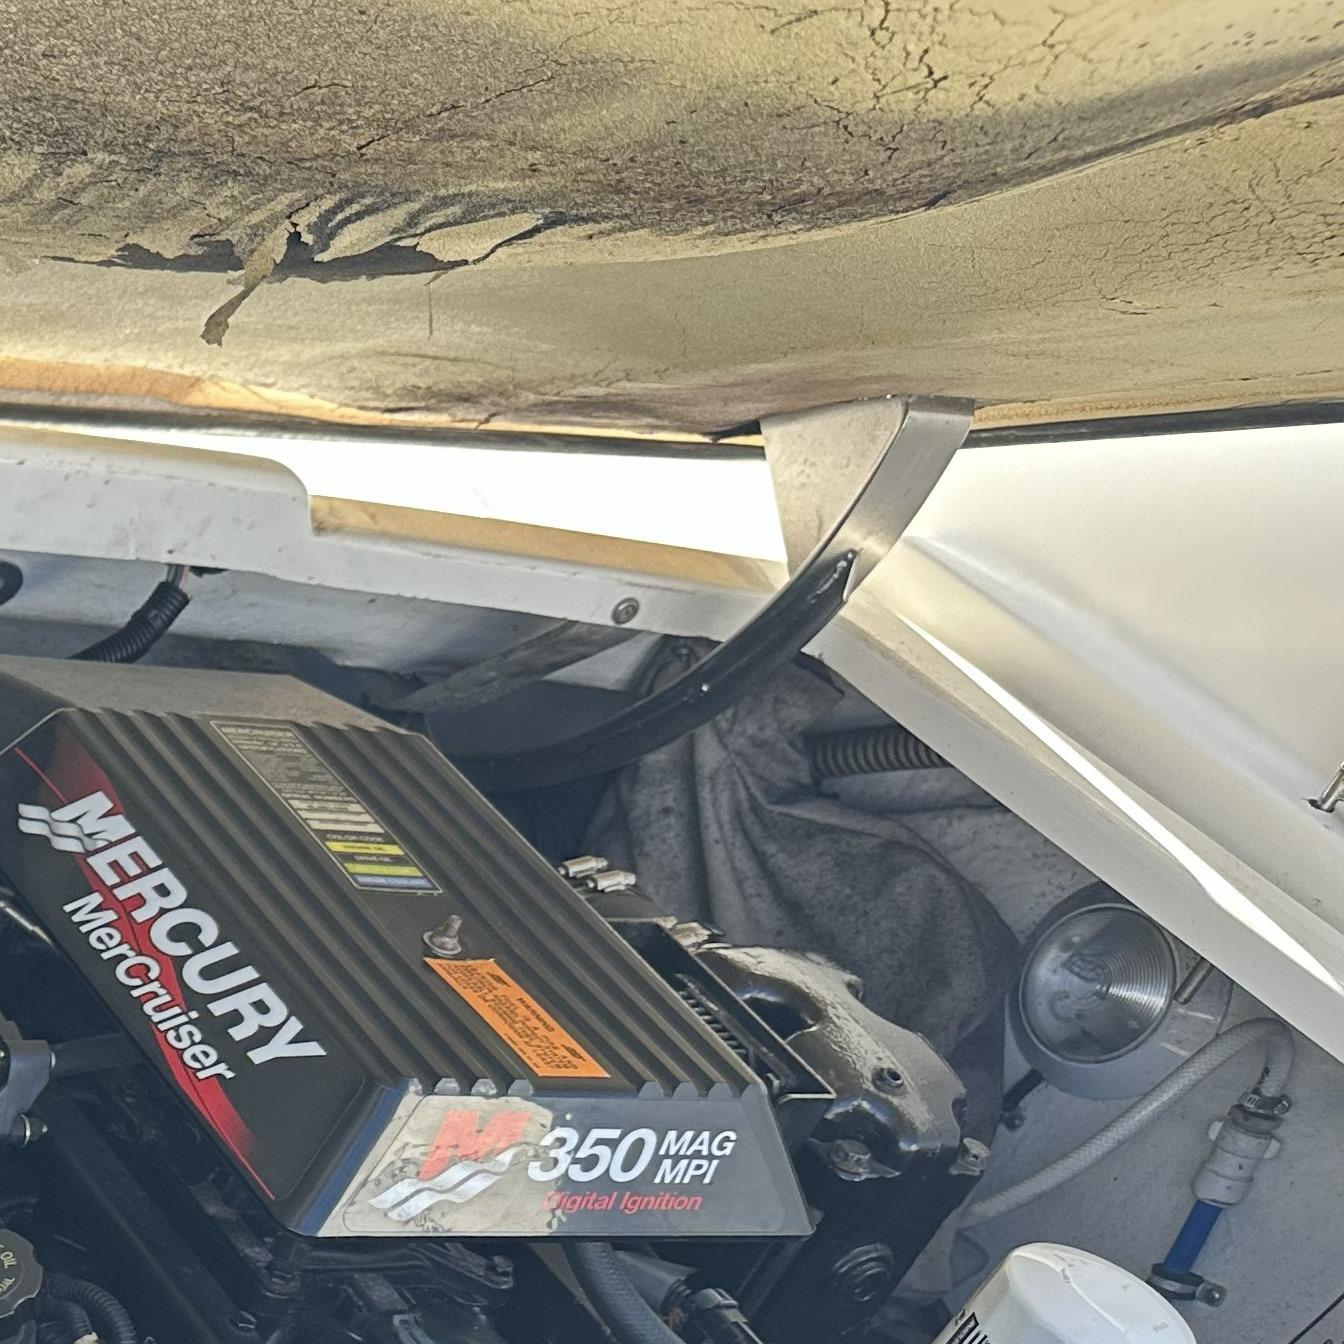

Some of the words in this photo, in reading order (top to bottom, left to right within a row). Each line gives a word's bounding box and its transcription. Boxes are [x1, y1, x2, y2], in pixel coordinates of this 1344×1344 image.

[53, 791, 326, 1066] MERCURY
[63, 895, 235, 1085] MerCruiser
[527, 1127, 654, 1184] 350
[659, 1131, 736, 1157] MAG
[652, 1159, 717, 1185] MPI
[615, 1190, 703, 1214] Ignition
[0, 1251, 17, 1269] OIL
